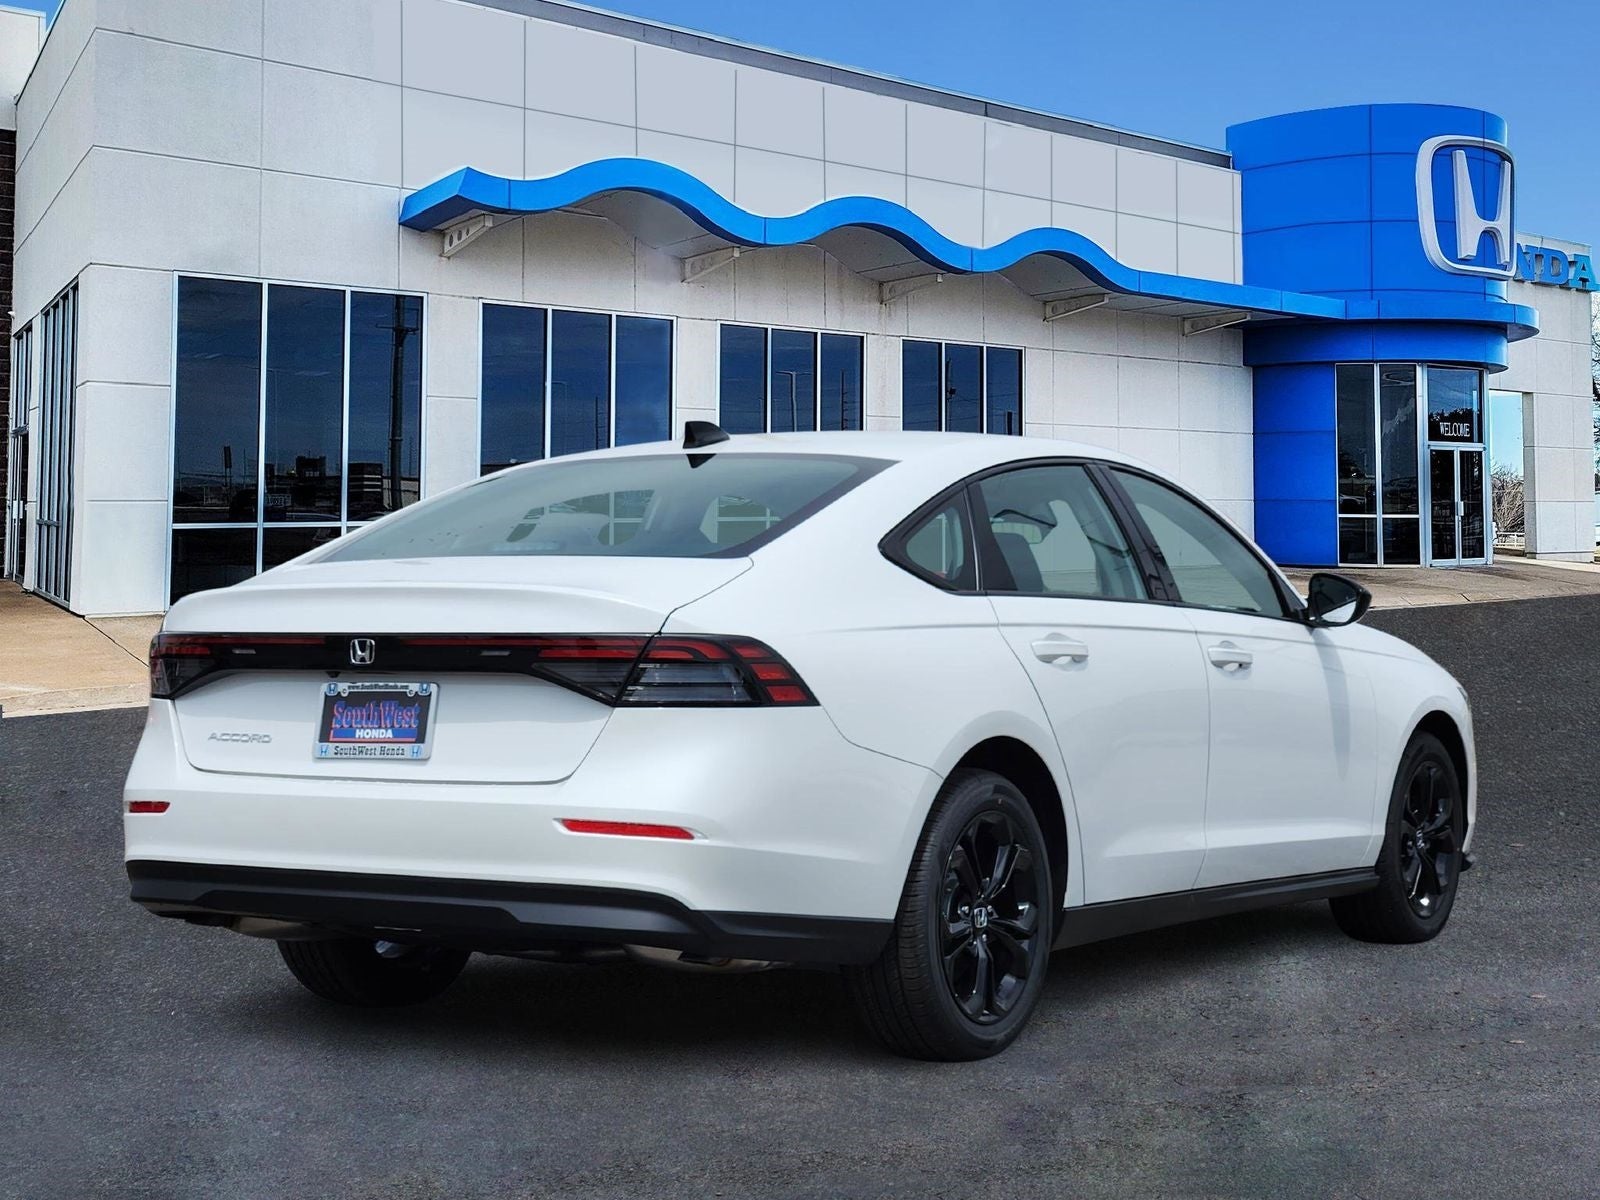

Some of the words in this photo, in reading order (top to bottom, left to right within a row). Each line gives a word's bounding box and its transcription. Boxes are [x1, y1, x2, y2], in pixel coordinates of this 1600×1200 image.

[1439, 422, 1471, 437] WELCOME
[331, 700, 421, 729] SouthWest
[208, 732, 273, 744] ACCORD
[355, 728, 394, 739] HONDA
[333, 745, 377, 756] SouthWest
[379, 746, 405, 756] Honda
